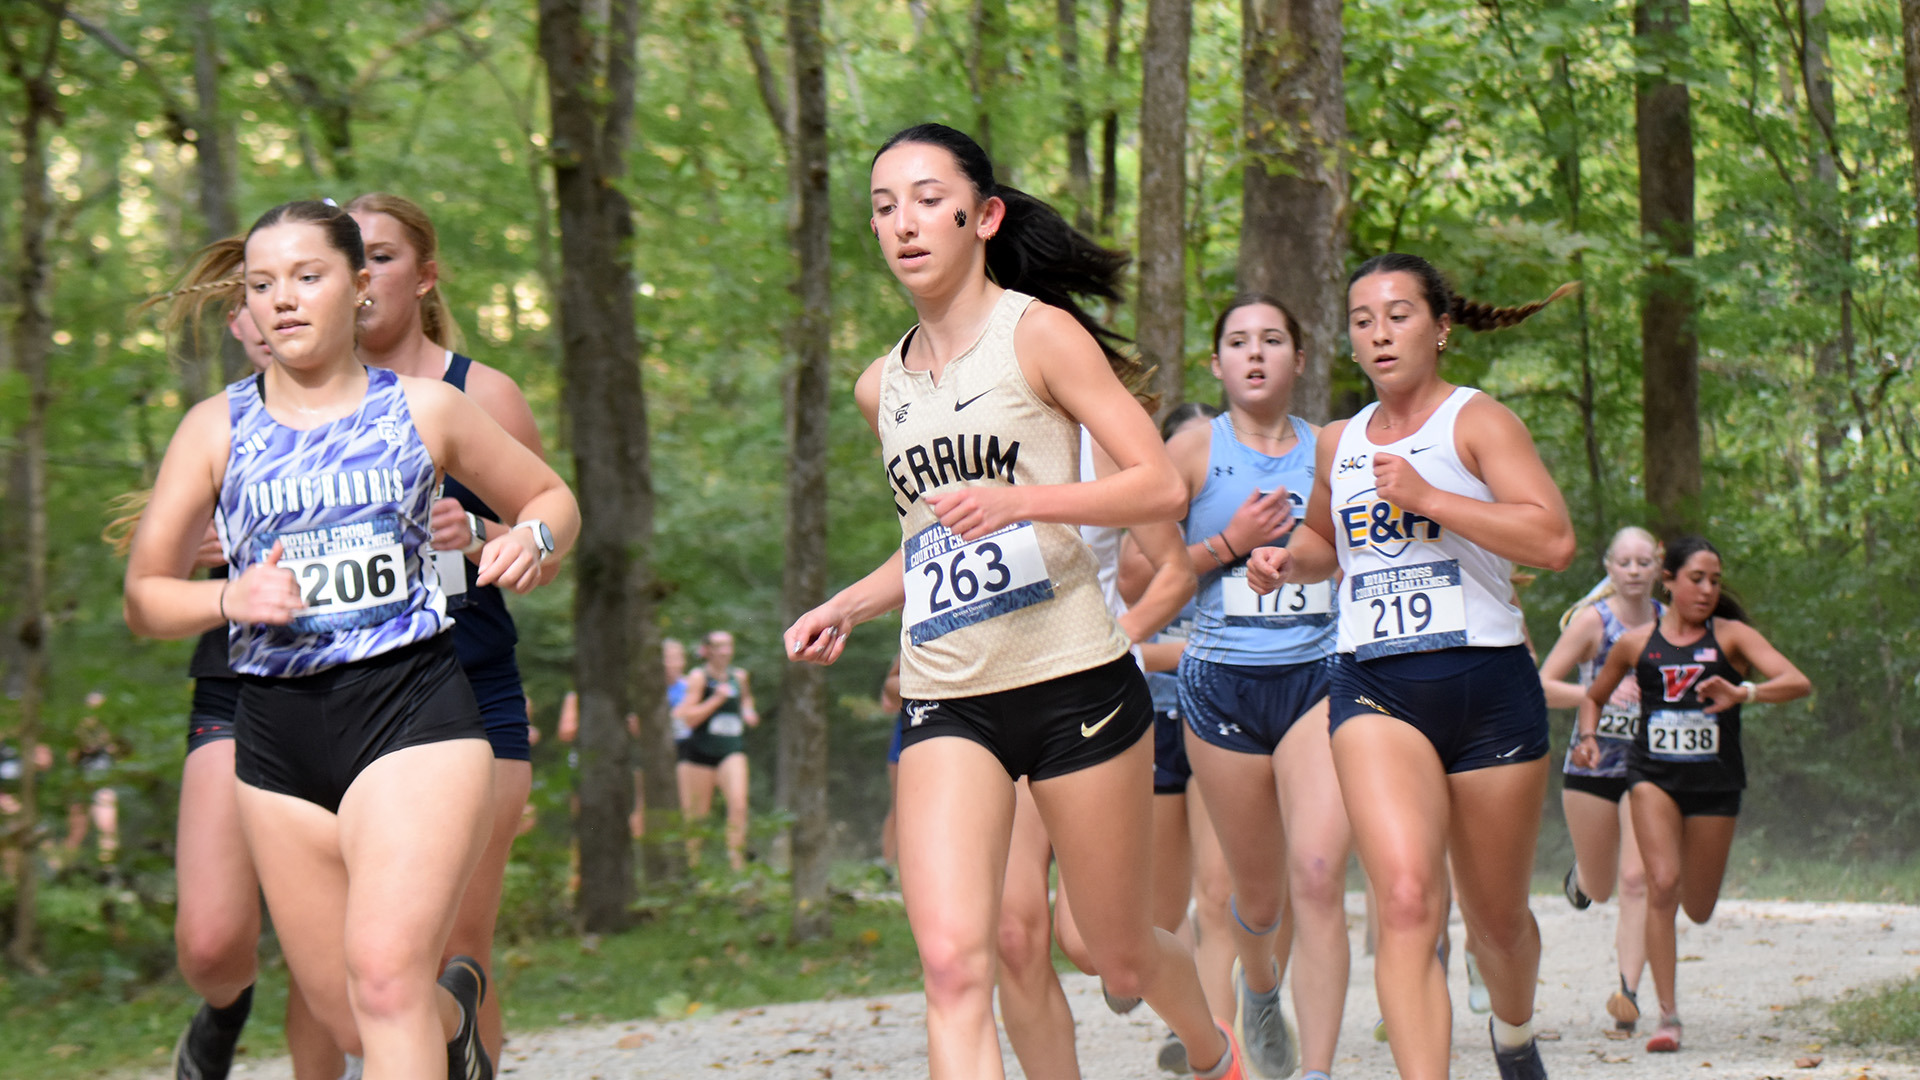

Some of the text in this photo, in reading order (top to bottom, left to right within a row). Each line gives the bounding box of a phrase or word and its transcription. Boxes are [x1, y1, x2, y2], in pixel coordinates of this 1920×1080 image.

[1339, 454, 1368, 475] SAC
[247, 467, 404, 518] YOUNG HARRIS
[279, 521, 374, 547] ROYALS CROSS
[919, 525, 953, 549] ROYALS
[1335, 500, 1443, 549] E&H
[261, 531, 396, 561] CNTRY CHALLENGE
[910, 540, 947, 567] COUNTRY
[279, 554, 396, 607] 206
[922, 541, 1011, 614] 263
[1355, 575, 1451, 600] COUNTRY CHALLENGE
[1363, 566, 1433, 586] ROYALS CROSS
[1369, 592, 1433, 639] 219
[1658, 664, 1706, 702] V
[1653, 727, 1713, 751] 2138
